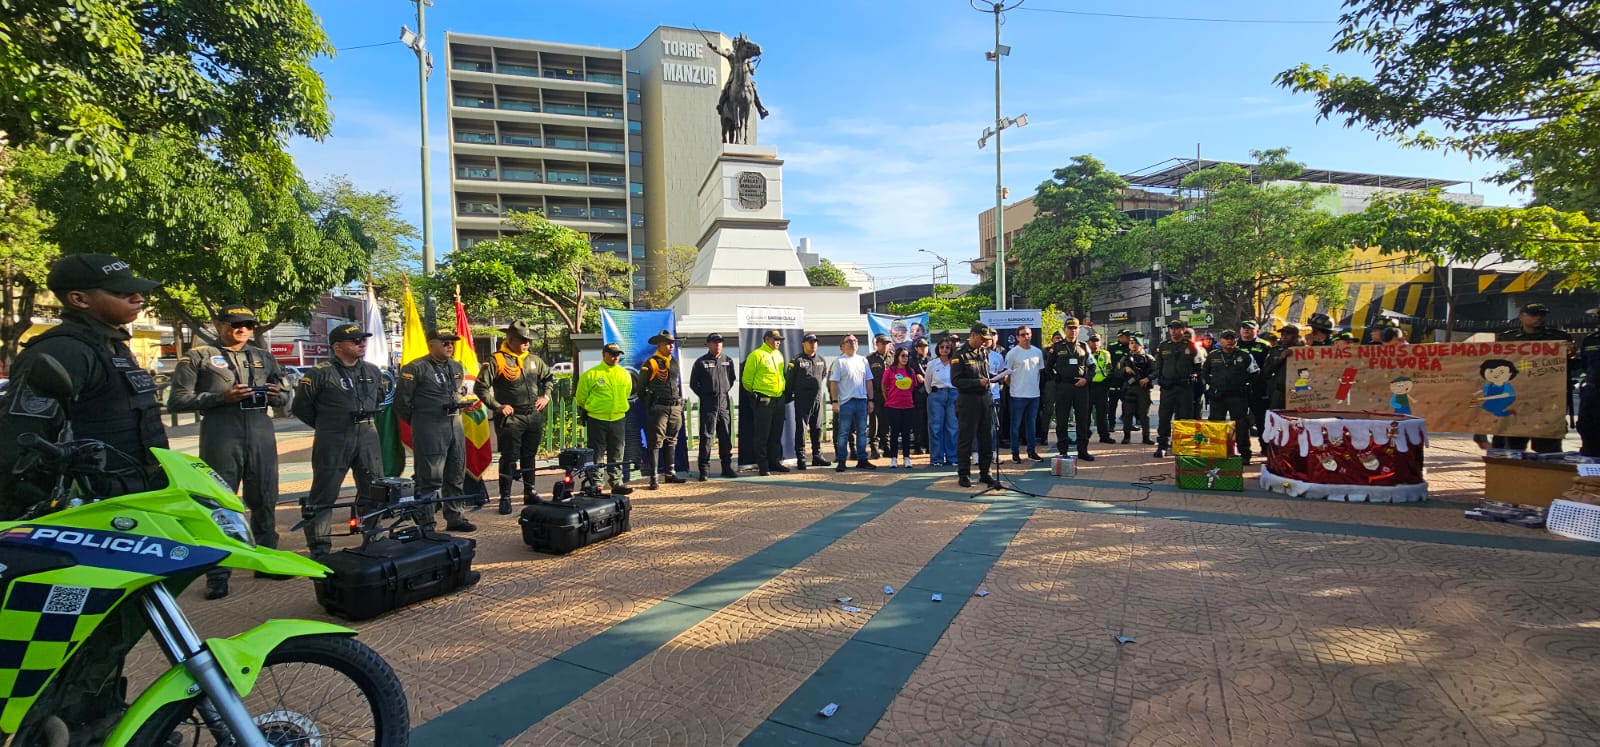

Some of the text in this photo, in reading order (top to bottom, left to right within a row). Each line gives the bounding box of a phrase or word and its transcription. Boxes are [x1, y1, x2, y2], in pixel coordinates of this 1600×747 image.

[662, 40, 704, 59] TORRE
[663, 63, 717, 85] MANZUR
[1295, 347, 1315, 361] NO
[30, 528, 164, 558] POLICÍA
